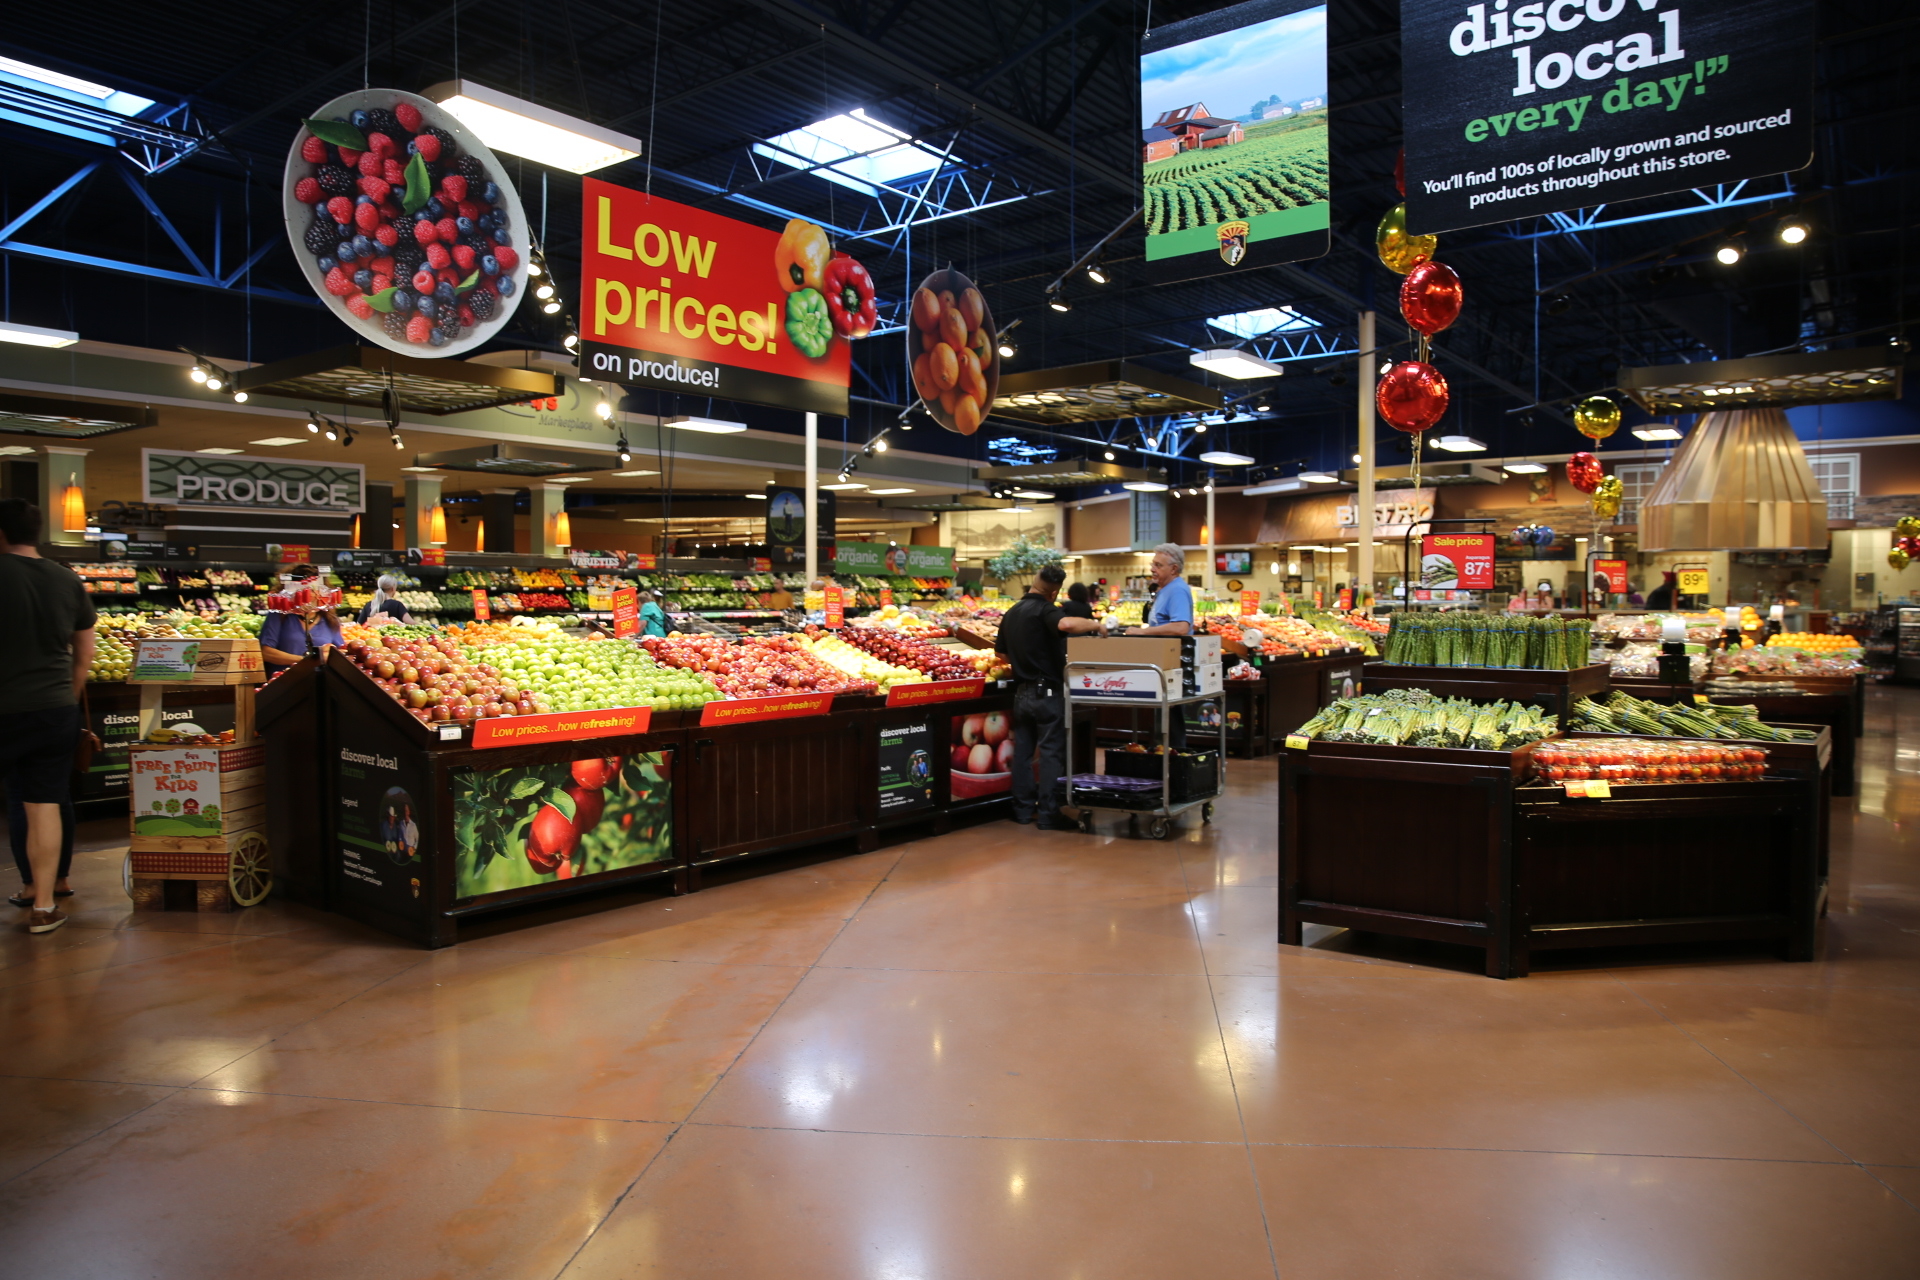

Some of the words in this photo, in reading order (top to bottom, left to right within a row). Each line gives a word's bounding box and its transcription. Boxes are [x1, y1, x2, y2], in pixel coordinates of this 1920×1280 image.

[1512, 9, 1685, 97] local
[1465, 95, 1593, 142] every
[1466, 167, 1496, 187] find
[1501, 163, 1535, 180] 100s
[1537, 155, 1555, 173] of
[1557, 147, 1611, 169] locally
[1614, 137, 1671, 162] grown
[1674, 125, 1710, 147] and
[1714, 108, 1791, 139] sourced
[1469, 183, 1540, 209] products
[1542, 164, 1640, 193] throughout
[1642, 156, 1676, 174] this
[1679, 149, 1731, 168] store.
[597, 195, 717, 279] Low
[594, 277, 777, 355] prices!
[592, 352, 622, 373] on
[628, 358, 719, 388] produce!
[539, 413, 593, 431] Marketplace
[176, 475, 350, 506] PRODUCE
[1336, 501, 1434, 525] BITRO
[1433, 537, 1455, 546] Sale
[1456, 537, 1483, 547] price
[570, 556, 619, 567] VARIETIES
[837, 550, 878, 566] organic
[909, 553, 945, 567] organic
[1095, 676, 1130, 692] Apples
[897, 691, 909, 700] Low
[715, 708, 732, 717] Low
[780, 699, 822, 711] refreshing!
[103, 715, 139, 724] disco
[162, 710, 193, 720] local
[104, 726, 139, 735] farm
[491, 727, 514, 738] Low
[580, 716, 635, 729] refreshing!
[880, 728, 909, 737] discover
[910, 724, 926, 733] local
[881, 737, 903, 746] farms
[135, 760, 171, 774] FREE
[173, 760, 217, 774] FRUIT
[341, 748, 375, 765] discover
[376, 754, 398, 770] local
[341, 763, 365, 779] farms
[154, 776, 198, 793] KIDS
